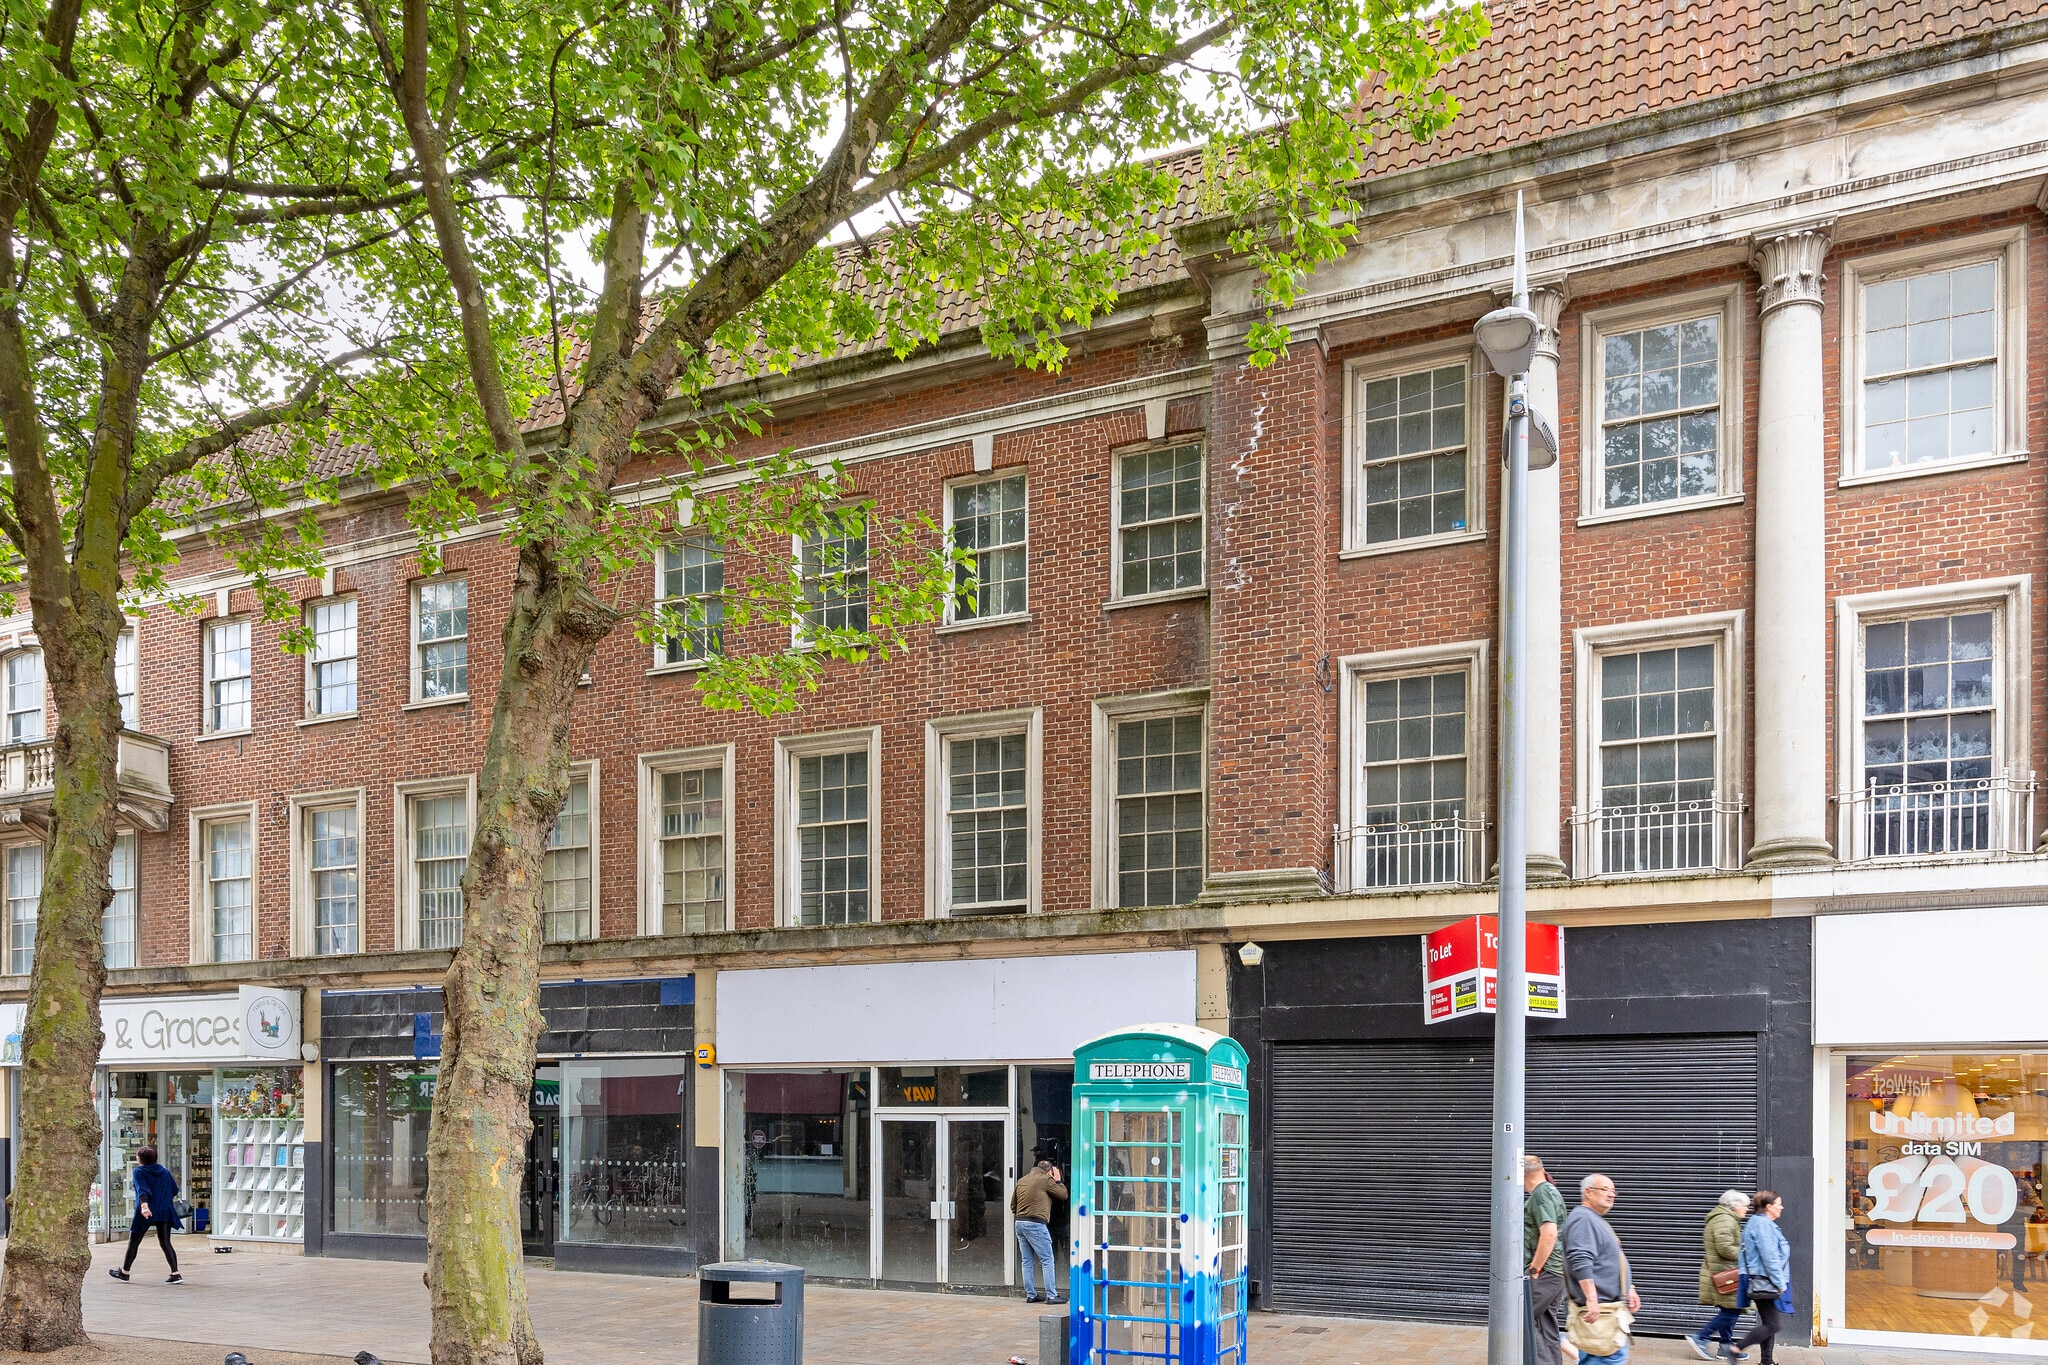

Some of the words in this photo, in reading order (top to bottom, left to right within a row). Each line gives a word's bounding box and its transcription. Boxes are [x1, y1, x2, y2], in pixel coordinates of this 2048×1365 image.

[1429, 948, 1438, 963] To
[1440, 942, 1452, 959] Let
[115, 1017, 133, 1050] &
[1095, 1064, 1186, 1078] TELEPHONE
[1212, 1064, 1241, 1084] TELEPHONE
[1869, 1110, 2015, 1136] Unlimited
[1901, 1141, 1941, 1156] data
[1945, 1141, 1982, 1156] SIM
[1865, 1163, 2018, 1225] £20
[1891, 1231, 1945, 1245] In-store
[1948, 1233, 1990, 1248] today
